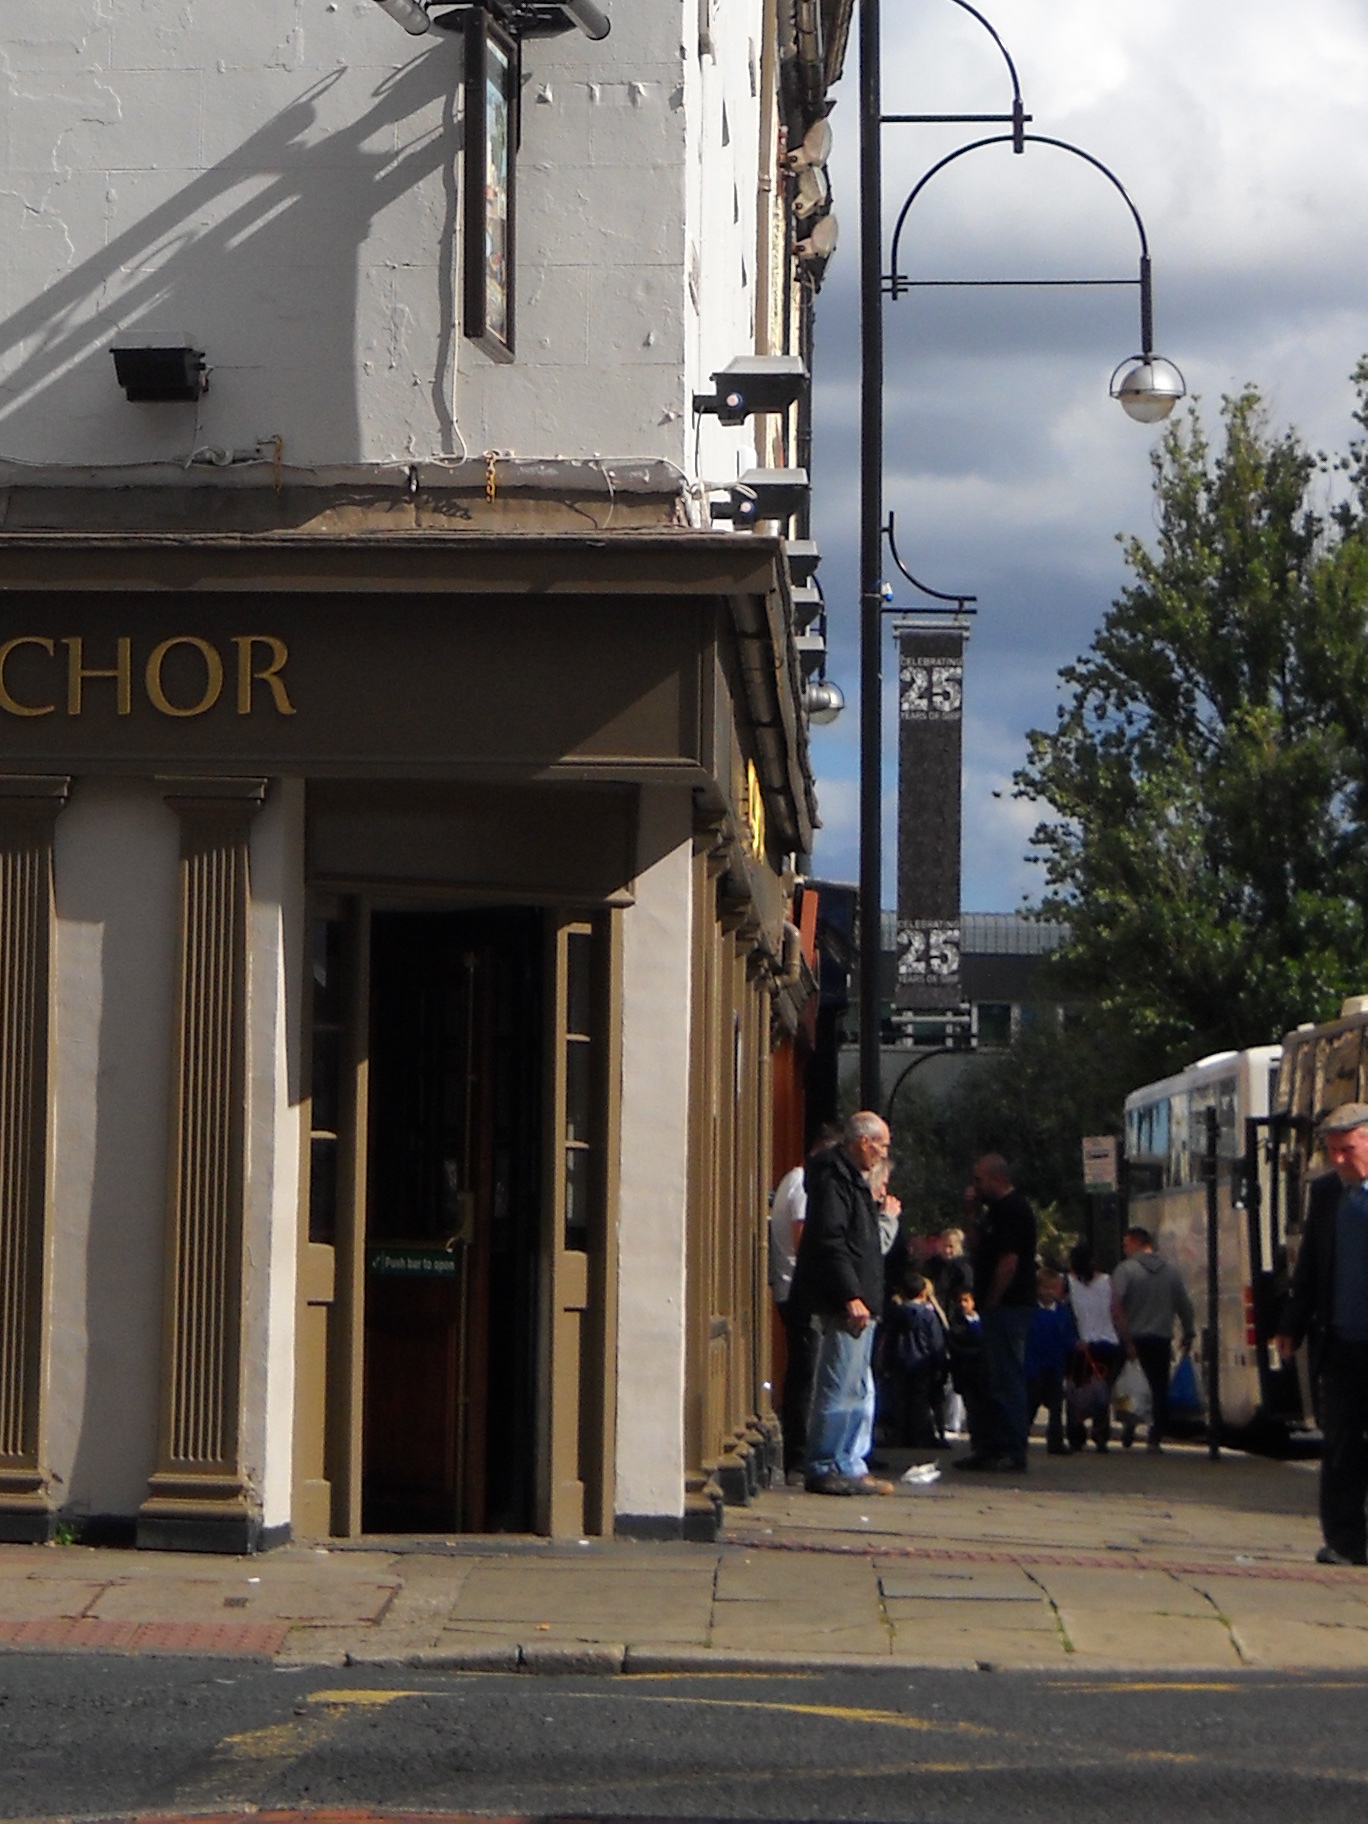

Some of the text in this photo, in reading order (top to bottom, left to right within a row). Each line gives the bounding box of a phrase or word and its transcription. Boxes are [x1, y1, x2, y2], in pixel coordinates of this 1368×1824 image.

[900, 656, 962, 666] CELEBRATING
[900, 666, 962, 712] 25
[900, 710, 927, 720] YEARS
[928, 710, 940, 720] OF
[897, 919, 960, 929] CELEBRATING
[897, 929, 960, 975] 25
[384, 1256, 455, 1274] Push bar to open
